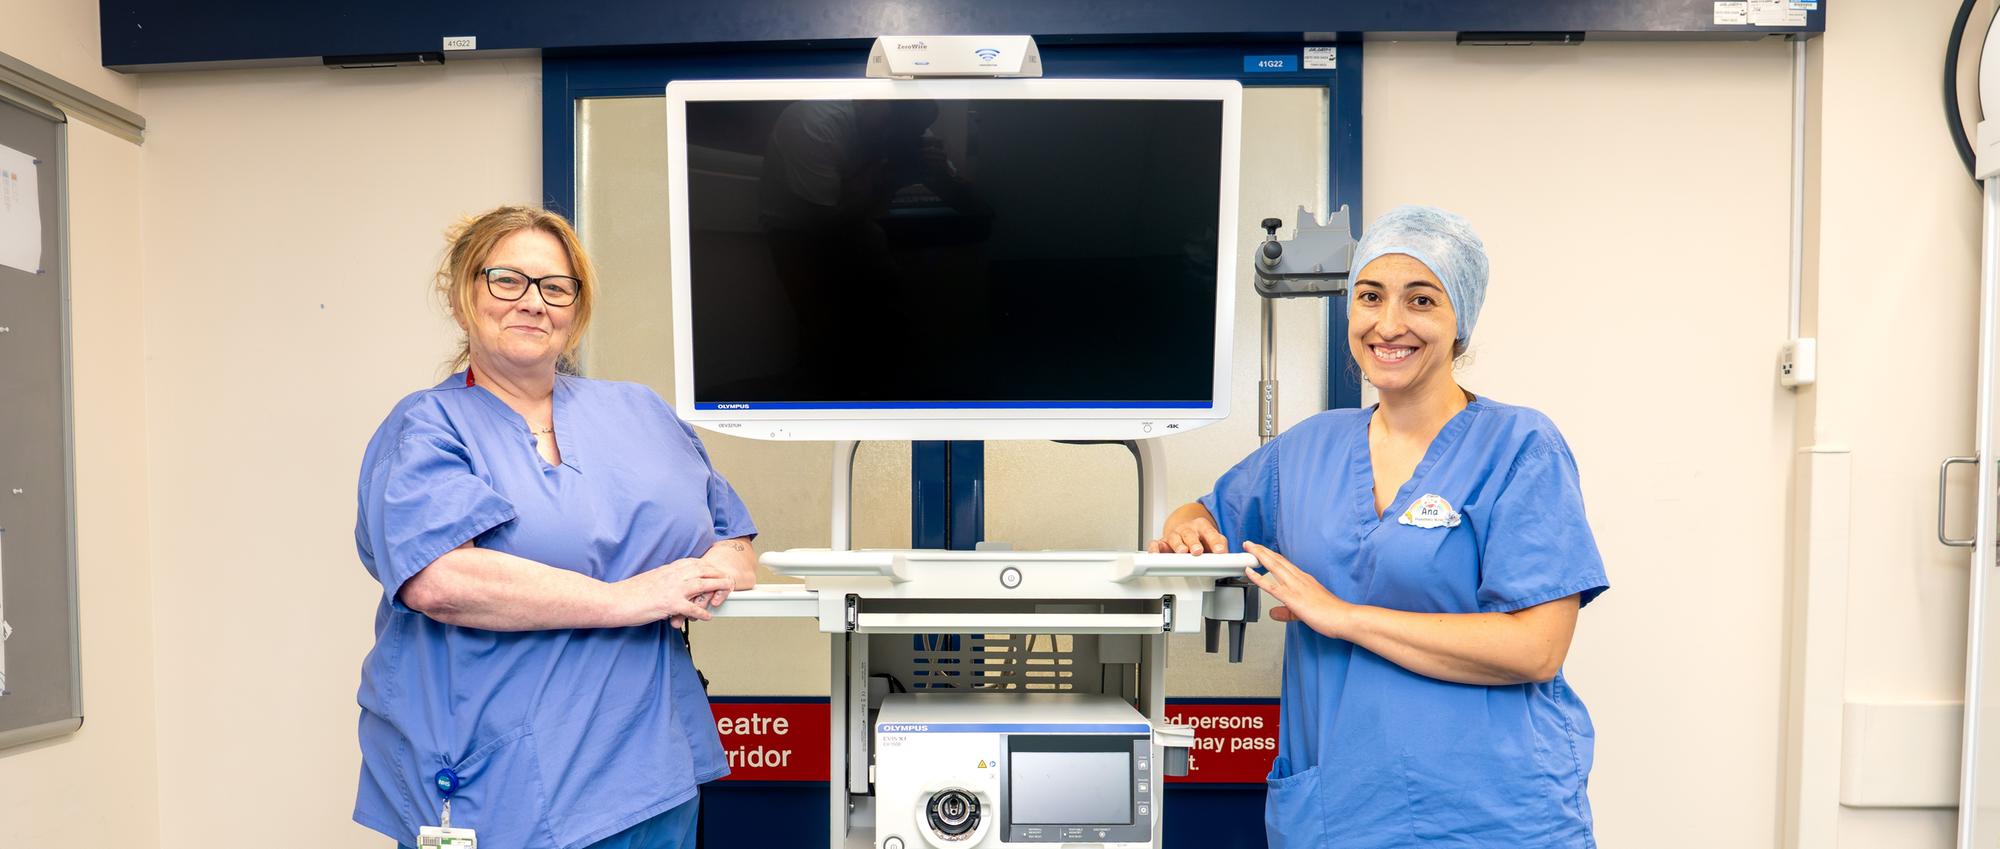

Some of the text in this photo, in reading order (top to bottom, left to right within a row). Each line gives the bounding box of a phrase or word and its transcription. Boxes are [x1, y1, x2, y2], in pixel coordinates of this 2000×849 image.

[1258, 60, 1283, 68] 41G22
[1421, 507, 1439, 516] Ana
[717, 713, 789, 735] eatre
[1188, 716, 1264, 729] persons
[1230, 737, 1276, 753] pass
[725, 745, 792, 768] ridor
